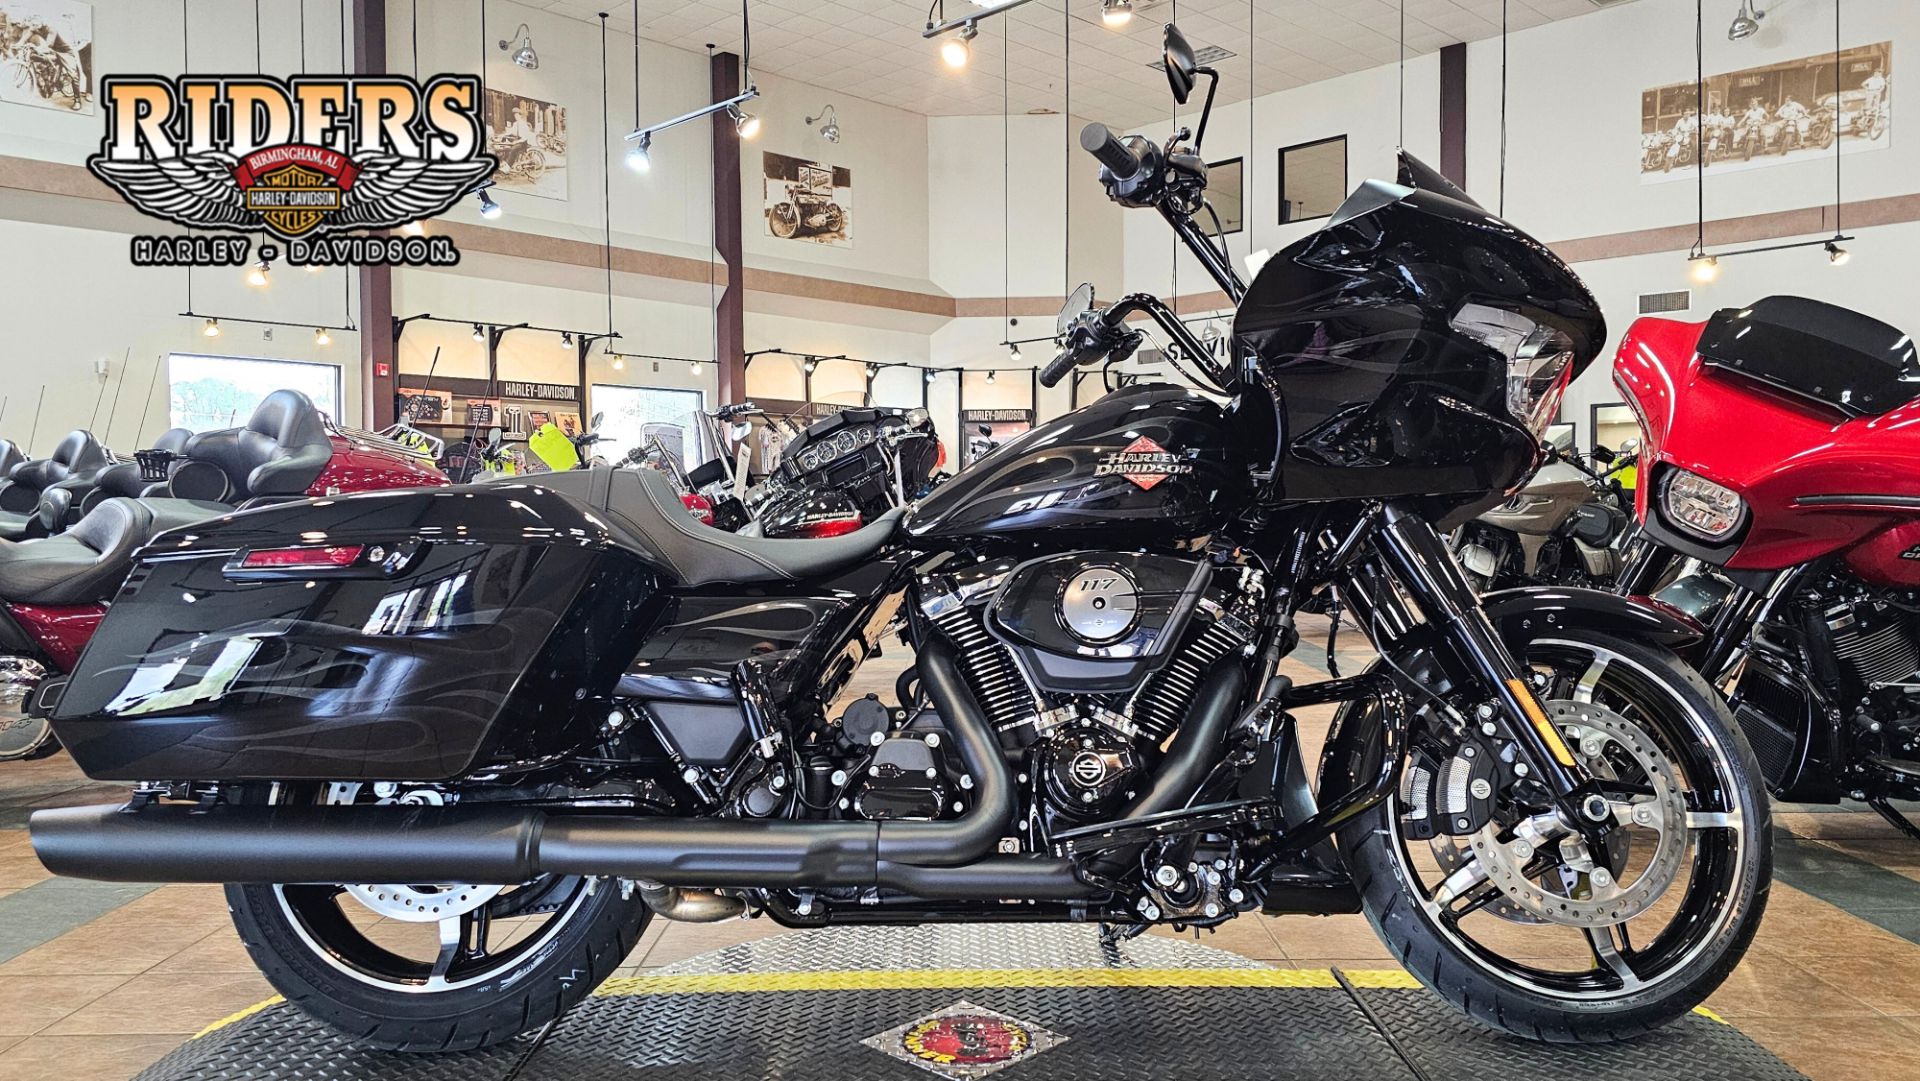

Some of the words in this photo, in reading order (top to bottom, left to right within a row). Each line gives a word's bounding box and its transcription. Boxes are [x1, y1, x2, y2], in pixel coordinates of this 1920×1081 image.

[505, 382, 575, 400] HARLEY-DAVIDSON
[968, 410, 1027, 421] HARLEY-DAVIDSON
[1108, 452, 1181, 465] HARLEY
[1093, 463, 1193, 476] DAVIDSON
[1080, 578, 1118, 592] 117
